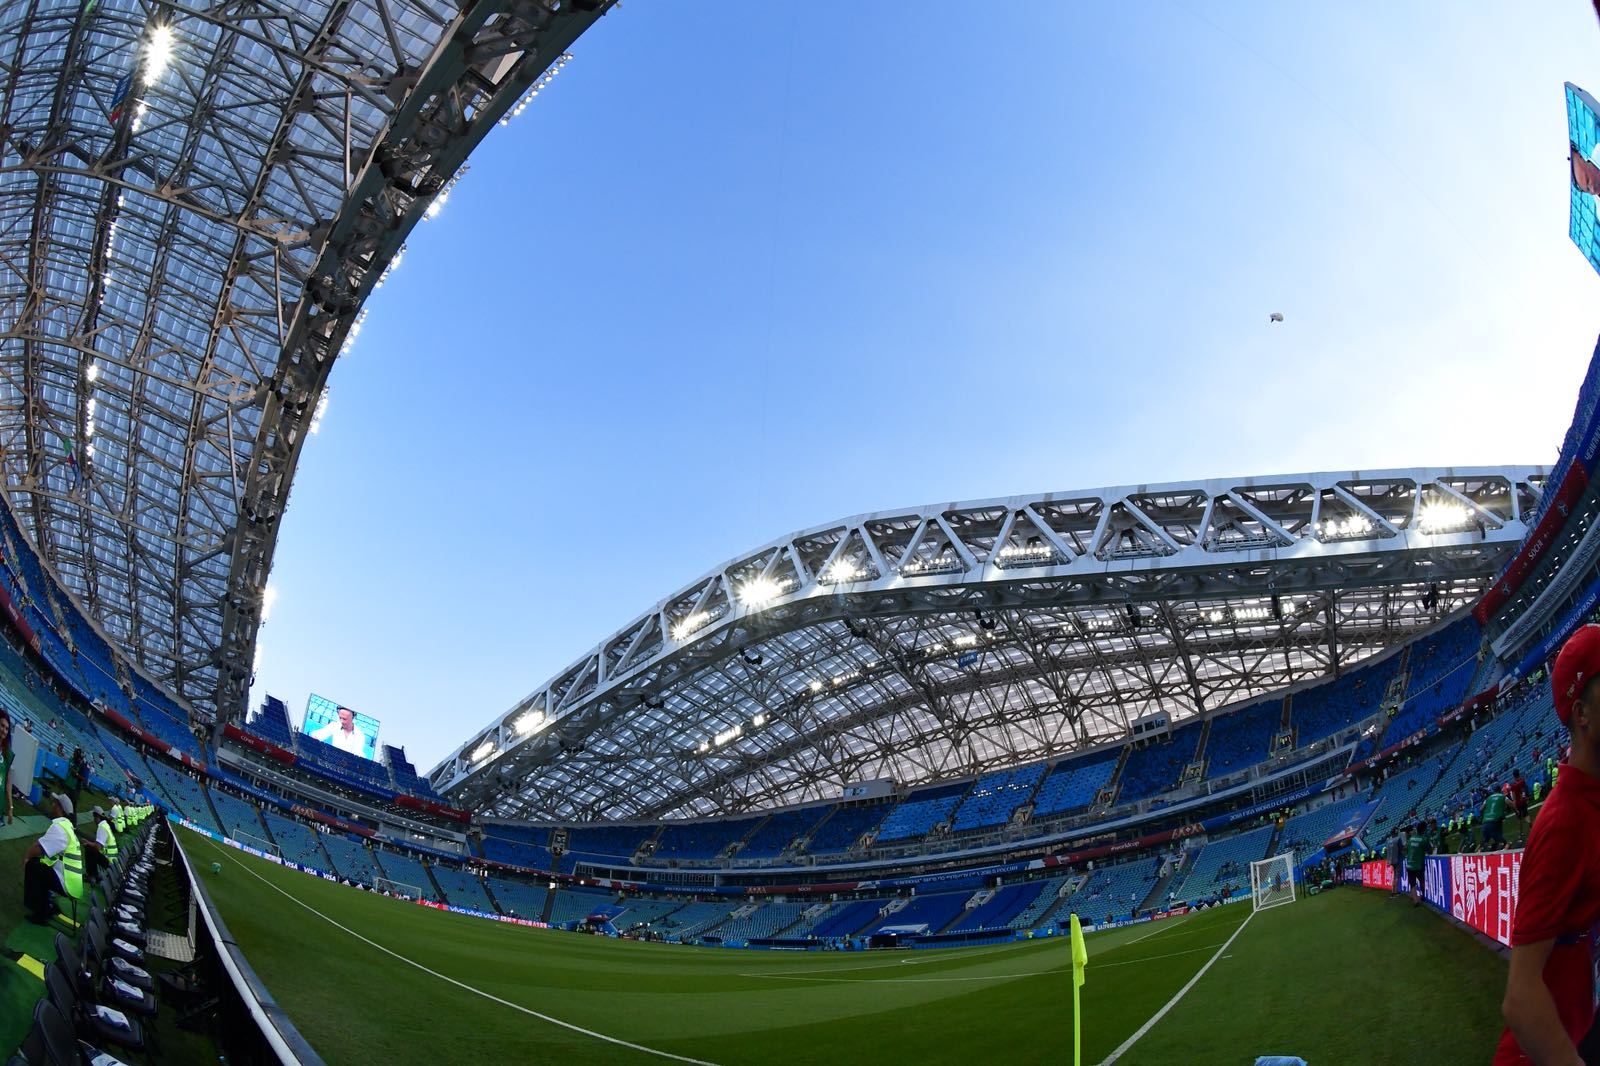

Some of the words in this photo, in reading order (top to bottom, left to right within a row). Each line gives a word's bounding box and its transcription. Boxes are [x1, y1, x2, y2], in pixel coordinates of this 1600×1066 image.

[1528, 540, 1544, 561] SOCHI
[960, 654, 975, 663] FIFA
[1230, 812, 1242, 821] 2018
[1242, 809, 1255, 817] FIFA
[1255, 802, 1276, 812] WORLD
[1276, 797, 1288, 806] CUP
[1289, 790, 1311, 801] RUSSIA
[179, 818, 212, 838] Hisense
[284, 860, 298, 870] VISA
[303, 866, 317, 877] VISA
[322, 872, 336, 882] VISA
[1424, 858, 1446, 908] ANDA
[1465, 855, 1491, 935] 蒙牛
[450, 906, 466, 914] vivo
[467, 909, 482, 917] vivo
[483, 912, 499, 920] vivo
